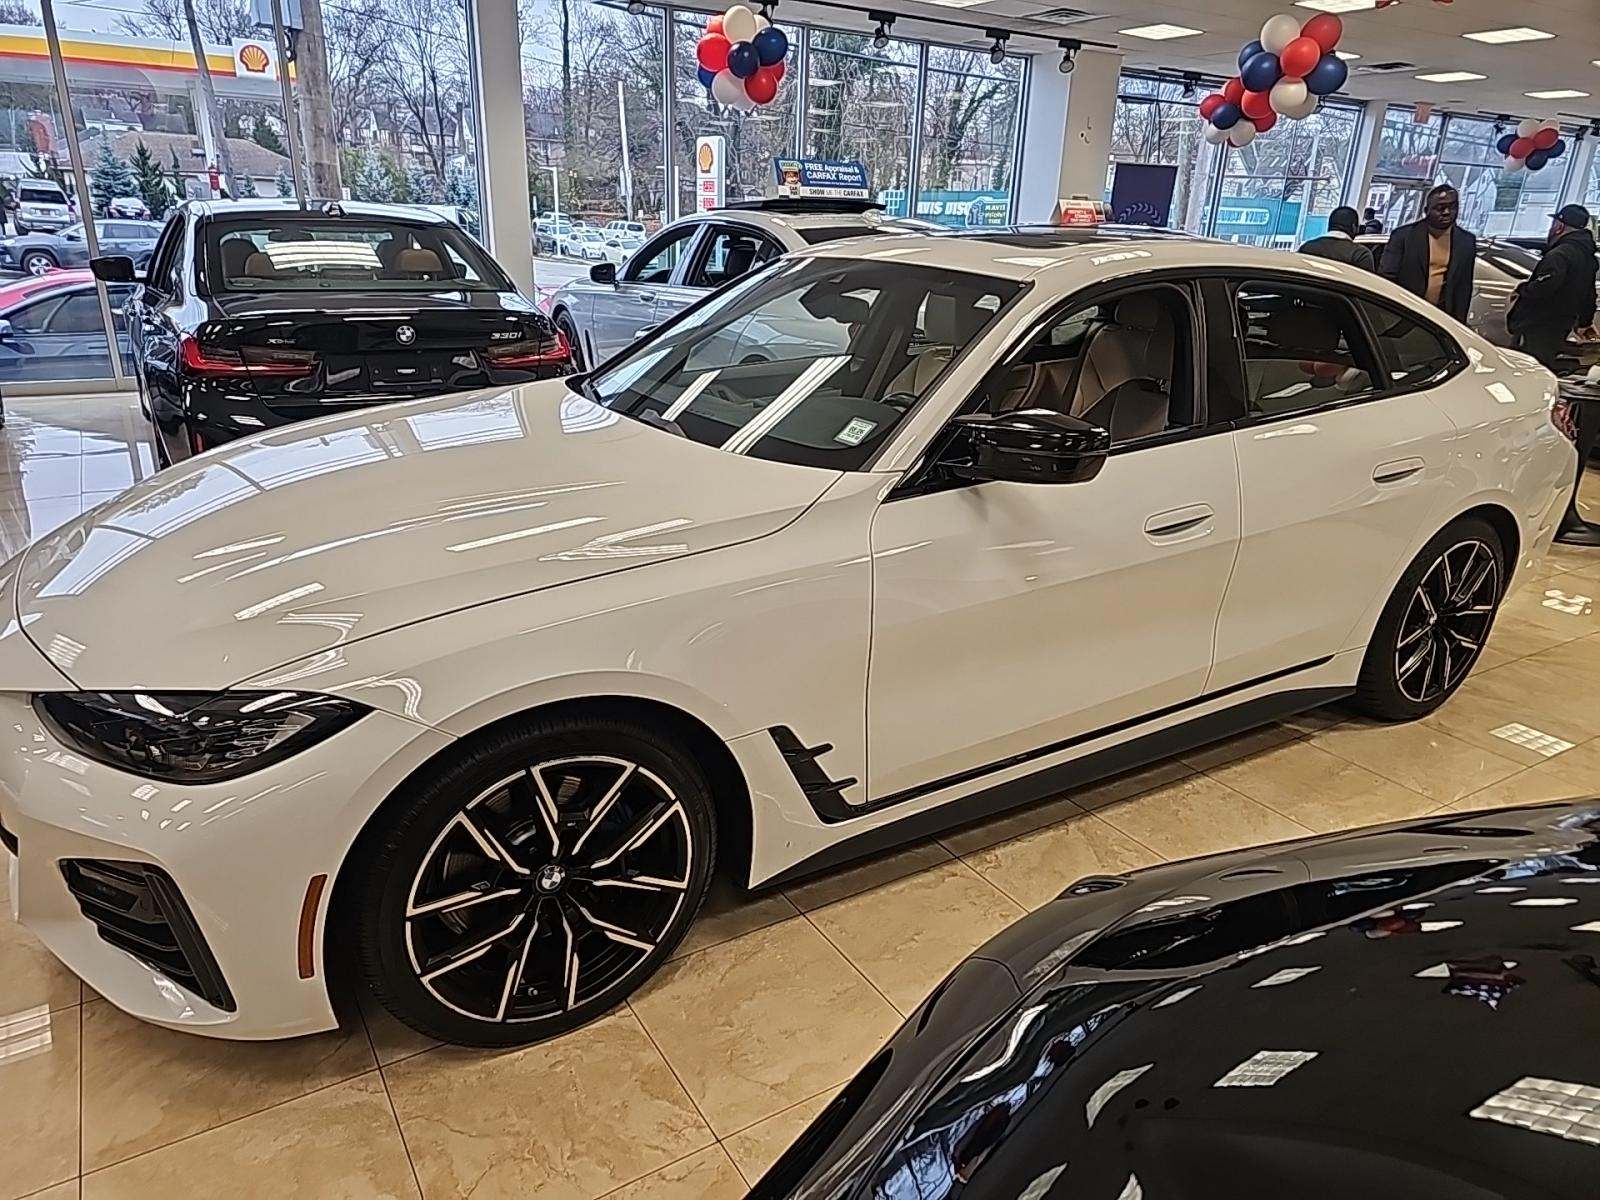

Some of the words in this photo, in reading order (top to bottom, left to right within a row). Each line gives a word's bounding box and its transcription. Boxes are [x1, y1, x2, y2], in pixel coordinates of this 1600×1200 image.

[804, 163, 823, 171] FREE
[825, 164, 853, 173] Appraisal
[806, 172, 837, 180] CARFAX
[839, 174, 862, 182] Report
[809, 188, 825, 196] SHOW
[917, 202, 943, 214] AVIS
